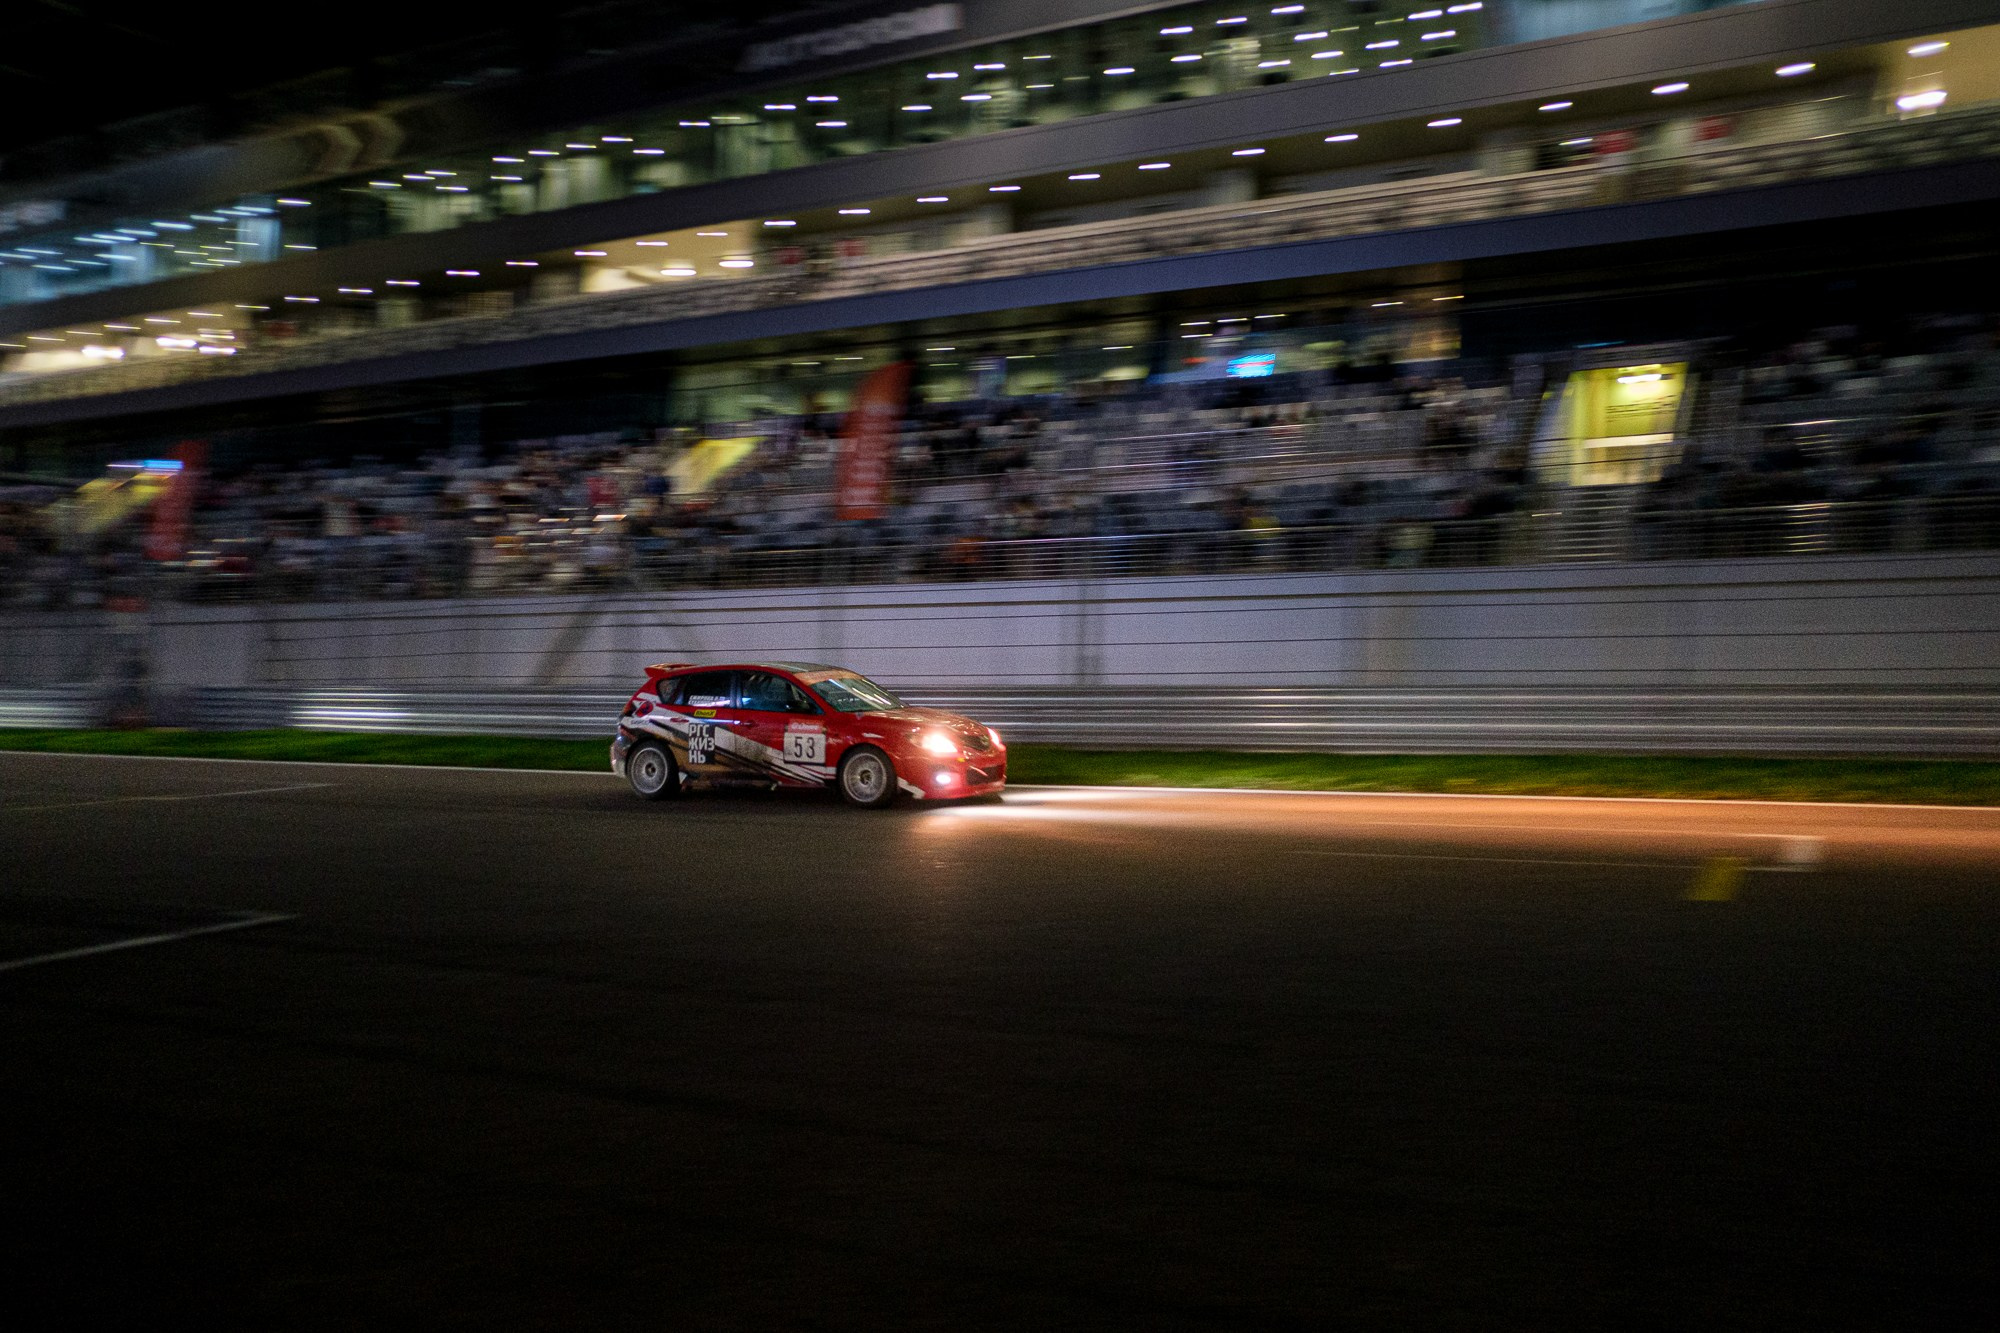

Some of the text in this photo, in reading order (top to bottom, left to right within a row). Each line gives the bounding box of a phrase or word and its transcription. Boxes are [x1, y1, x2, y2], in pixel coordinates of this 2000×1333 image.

[688, 724, 710, 738] РГС
[688, 737, 716, 751] ЖИЗ
[794, 736, 816, 759] 53
[688, 750, 707, 764] НЬ
